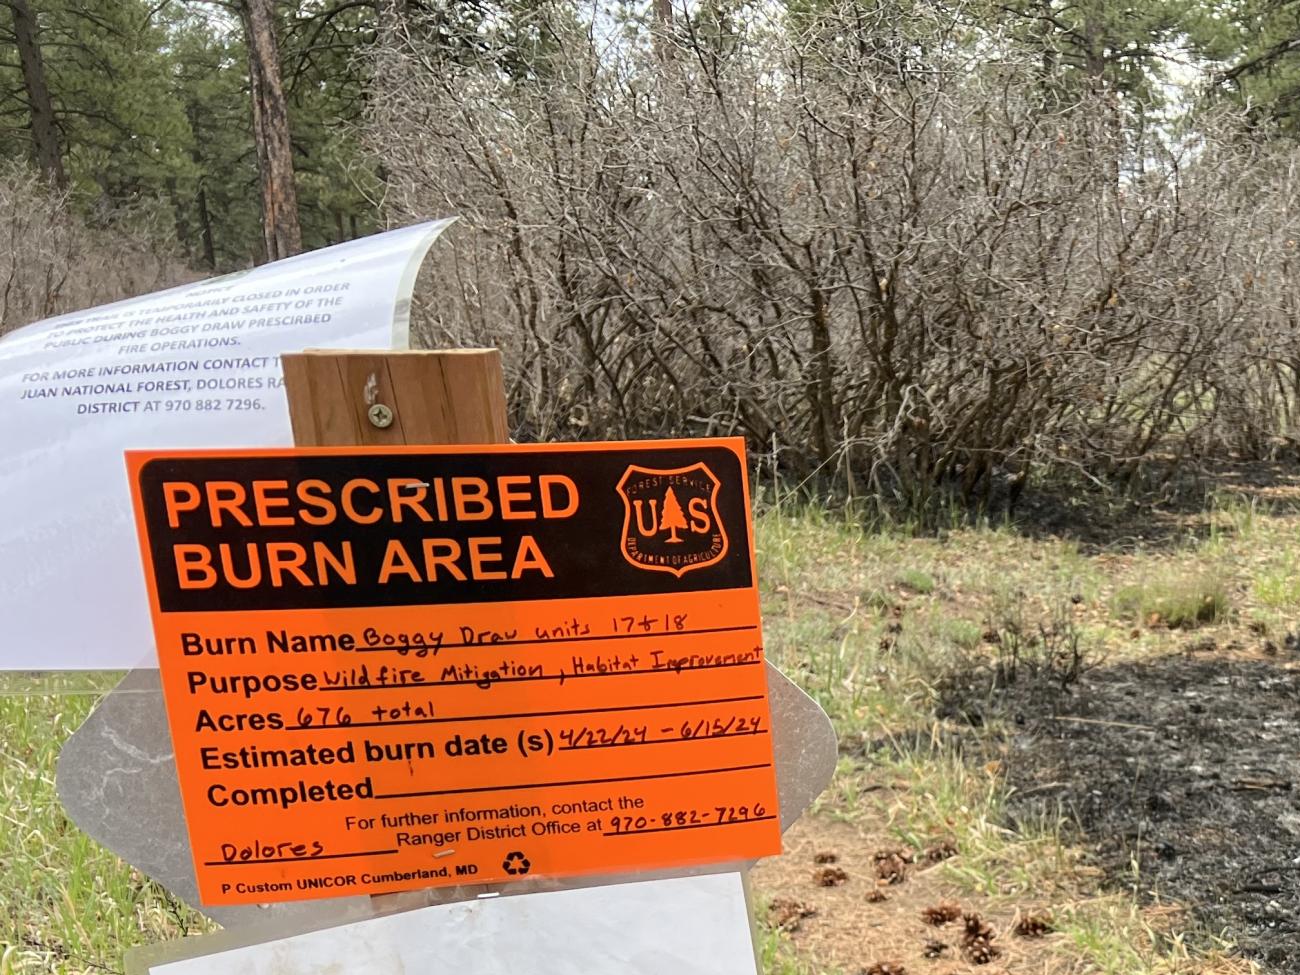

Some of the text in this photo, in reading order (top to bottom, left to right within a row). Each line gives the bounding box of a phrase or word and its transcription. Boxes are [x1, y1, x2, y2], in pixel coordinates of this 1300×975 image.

[65, 321, 126, 336] PROTECT
[128, 316, 154, 327] THE
[155, 309, 207, 324] HEALTH
[208, 306, 239, 318] AND
[241, 301, 293, 314] SAFETY
[294, 298, 314, 309] OF
[317, 296, 344, 307] THE
[139, 296, 231, 315] TEMPORARILY
[231, 289, 283, 303] CLOSED
[285, 287, 300, 297] IN
[303, 282, 351, 294] ORDER
[43, 312, 332, 349] PUBLIC DURING BOGGY DRAW PRESCIRBED
[117, 335, 241, 355] FIRE OPERATIONS.
[22, 372, 49, 383] FOR
[52, 367, 96, 381] MORE
[98, 360, 199, 377] INFORMATION
[203, 356, 270, 370] CONTACT
[20, 377, 285, 400] JUAN NATIONAL FOREST, DOLORES RA
[77, 398, 265, 415] DISTRICT AT 970 882 7296.
[161, 474, 580, 528] PRESCRIBED
[172, 535, 555, 589] BURN AREA
[180, 631, 257, 656] Burn
[265, 630, 355, 654] Name
[362, 626, 443, 658] Boggy
[459, 626, 518, 646] Draw
[535, 621, 591, 641] units
[187, 670, 318, 699] Purpose
[572, 654, 640, 676] Habitat
[650, 646, 763, 675] Improvement
[195, 701, 435, 732] Acres 676 total
[200, 740, 355, 770] Estimated
[364, 739, 435, 763] burn
[445, 733, 508, 757] date
[517, 728, 554, 758] (s)
[559, 724, 648, 747] 4/22/24
[680, 716, 762, 738] 6/15/24
[207, 776, 374, 810] Completed
[345, 796, 645, 831] For further information, contact the
[221, 802, 766, 863] Dolores Ranger District Office at 970-882-7296
[221, 863, 479, 895] P Custom UNICOR Cumberland, MD
